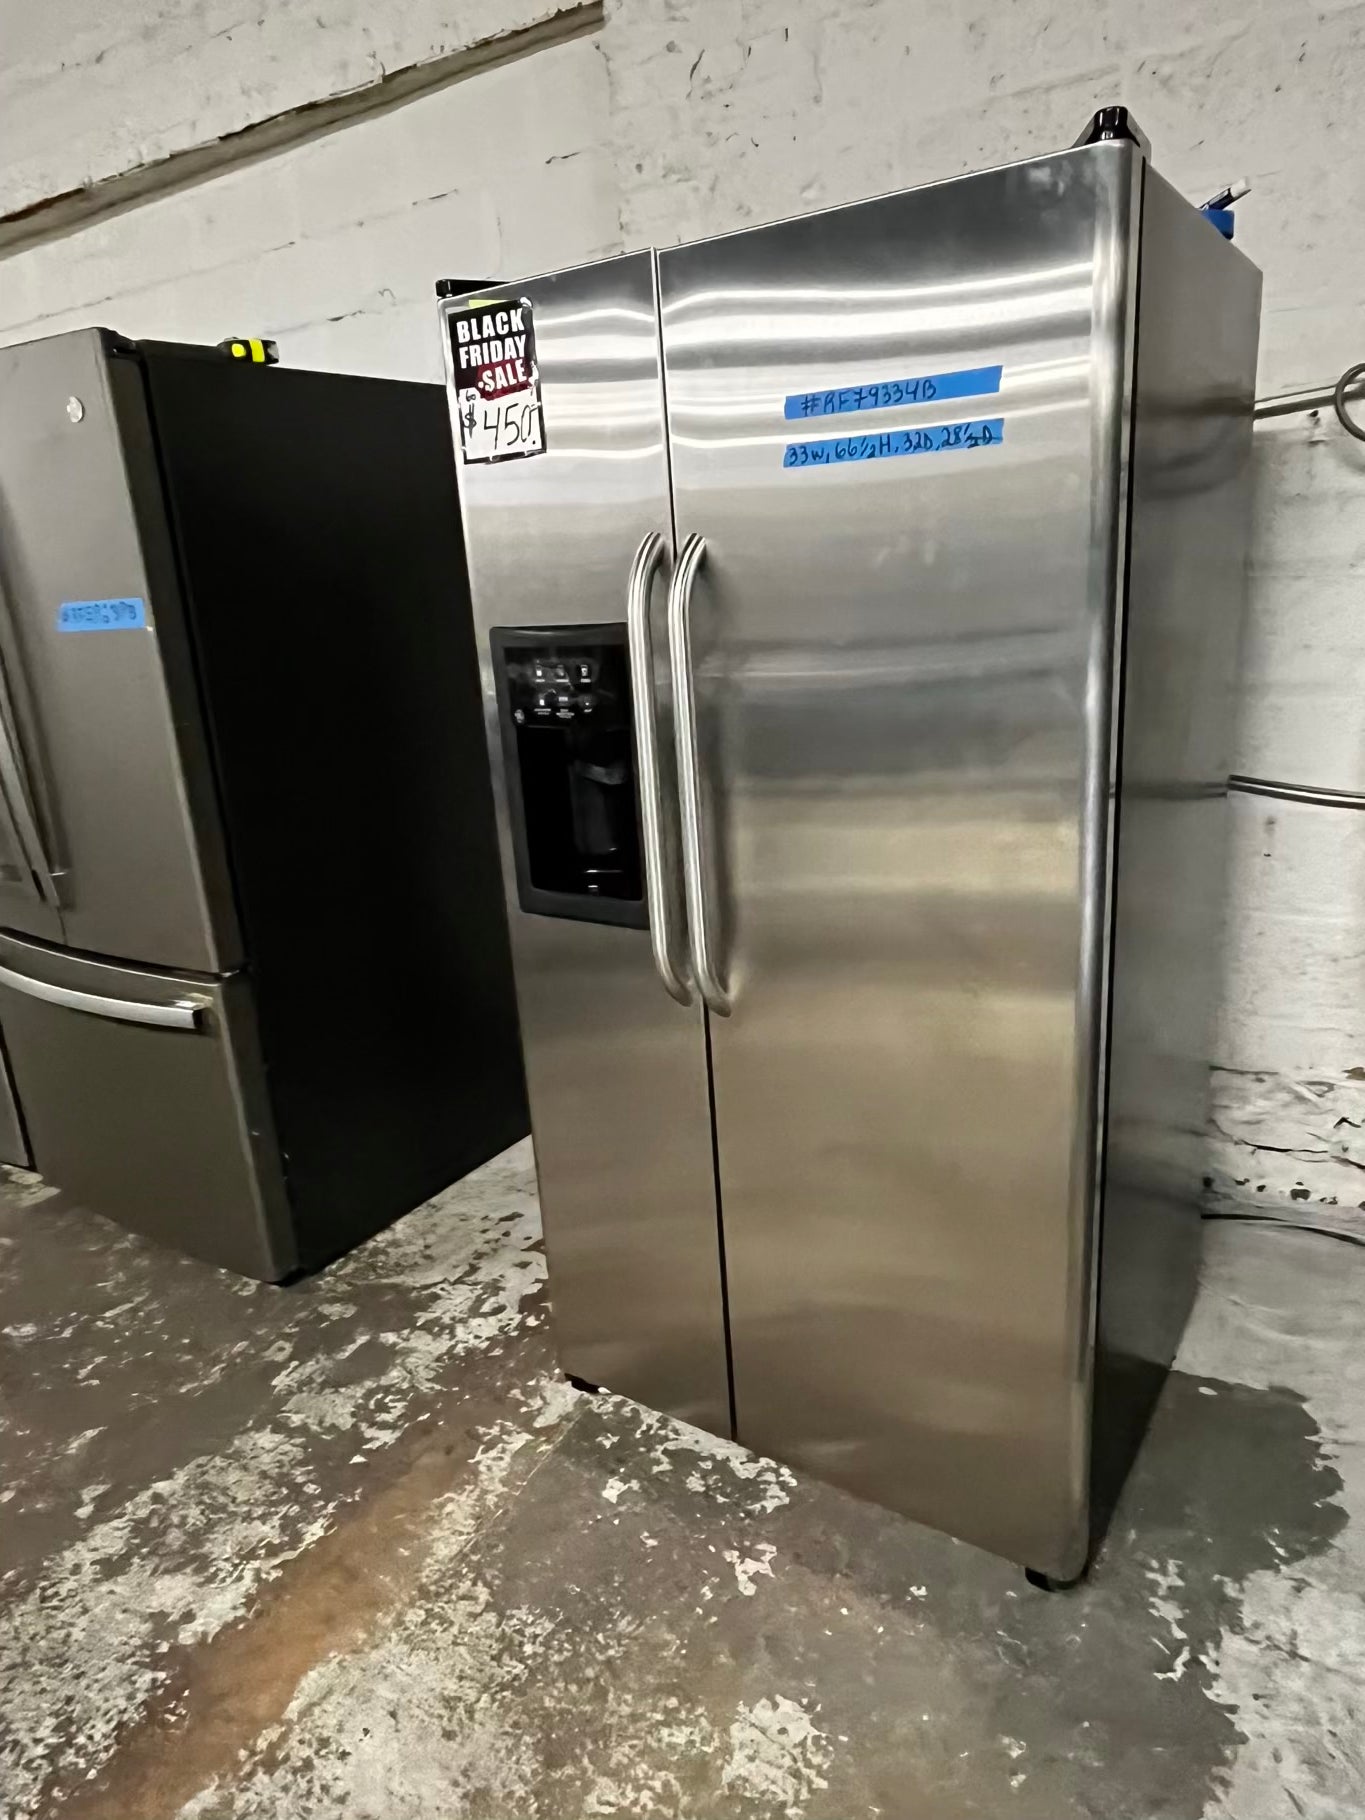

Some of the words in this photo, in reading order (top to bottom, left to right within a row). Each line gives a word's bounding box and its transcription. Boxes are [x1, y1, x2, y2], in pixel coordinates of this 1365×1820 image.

[456, 308, 525, 344] BLACK
[459, 334, 526, 369] FRIDAY
[482, 359, 527, 392] SALE
